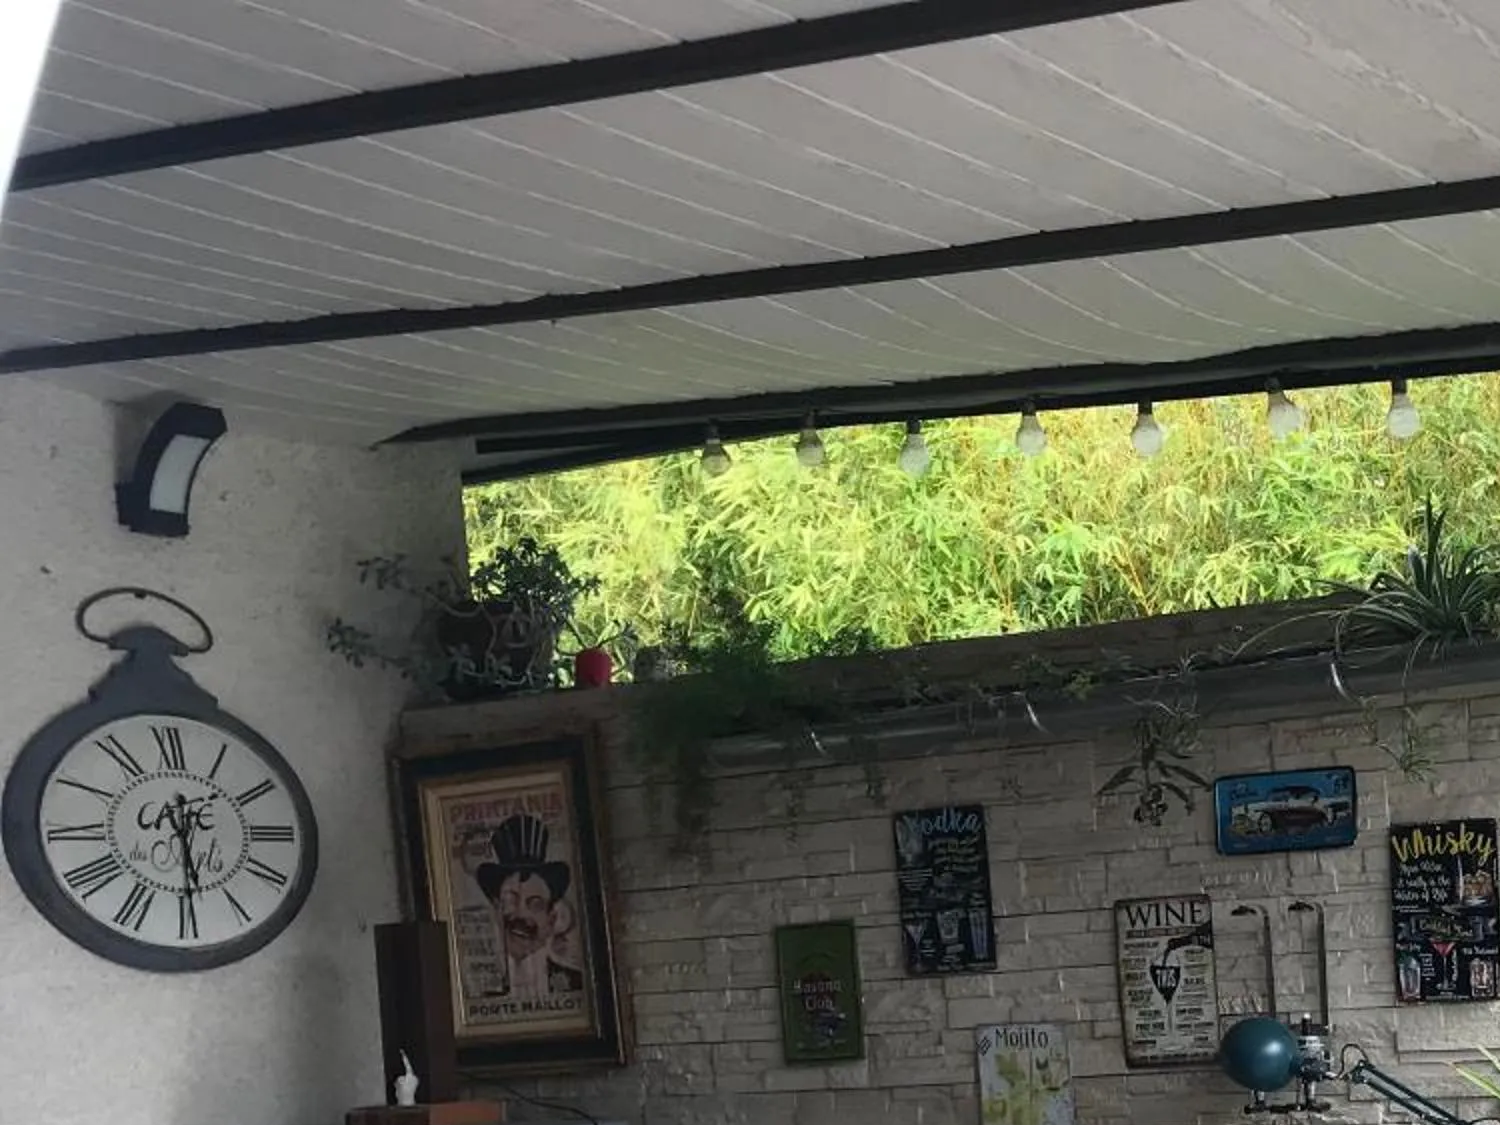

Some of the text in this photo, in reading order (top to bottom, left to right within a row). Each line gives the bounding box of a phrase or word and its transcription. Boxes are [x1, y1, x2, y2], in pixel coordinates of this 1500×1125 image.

[150, 726, 186, 770] XII
[1391, 822, 1496, 867] Whisky
[1125, 901, 1203, 928] WINE
[995, 1027, 1049, 1050] Mojito
